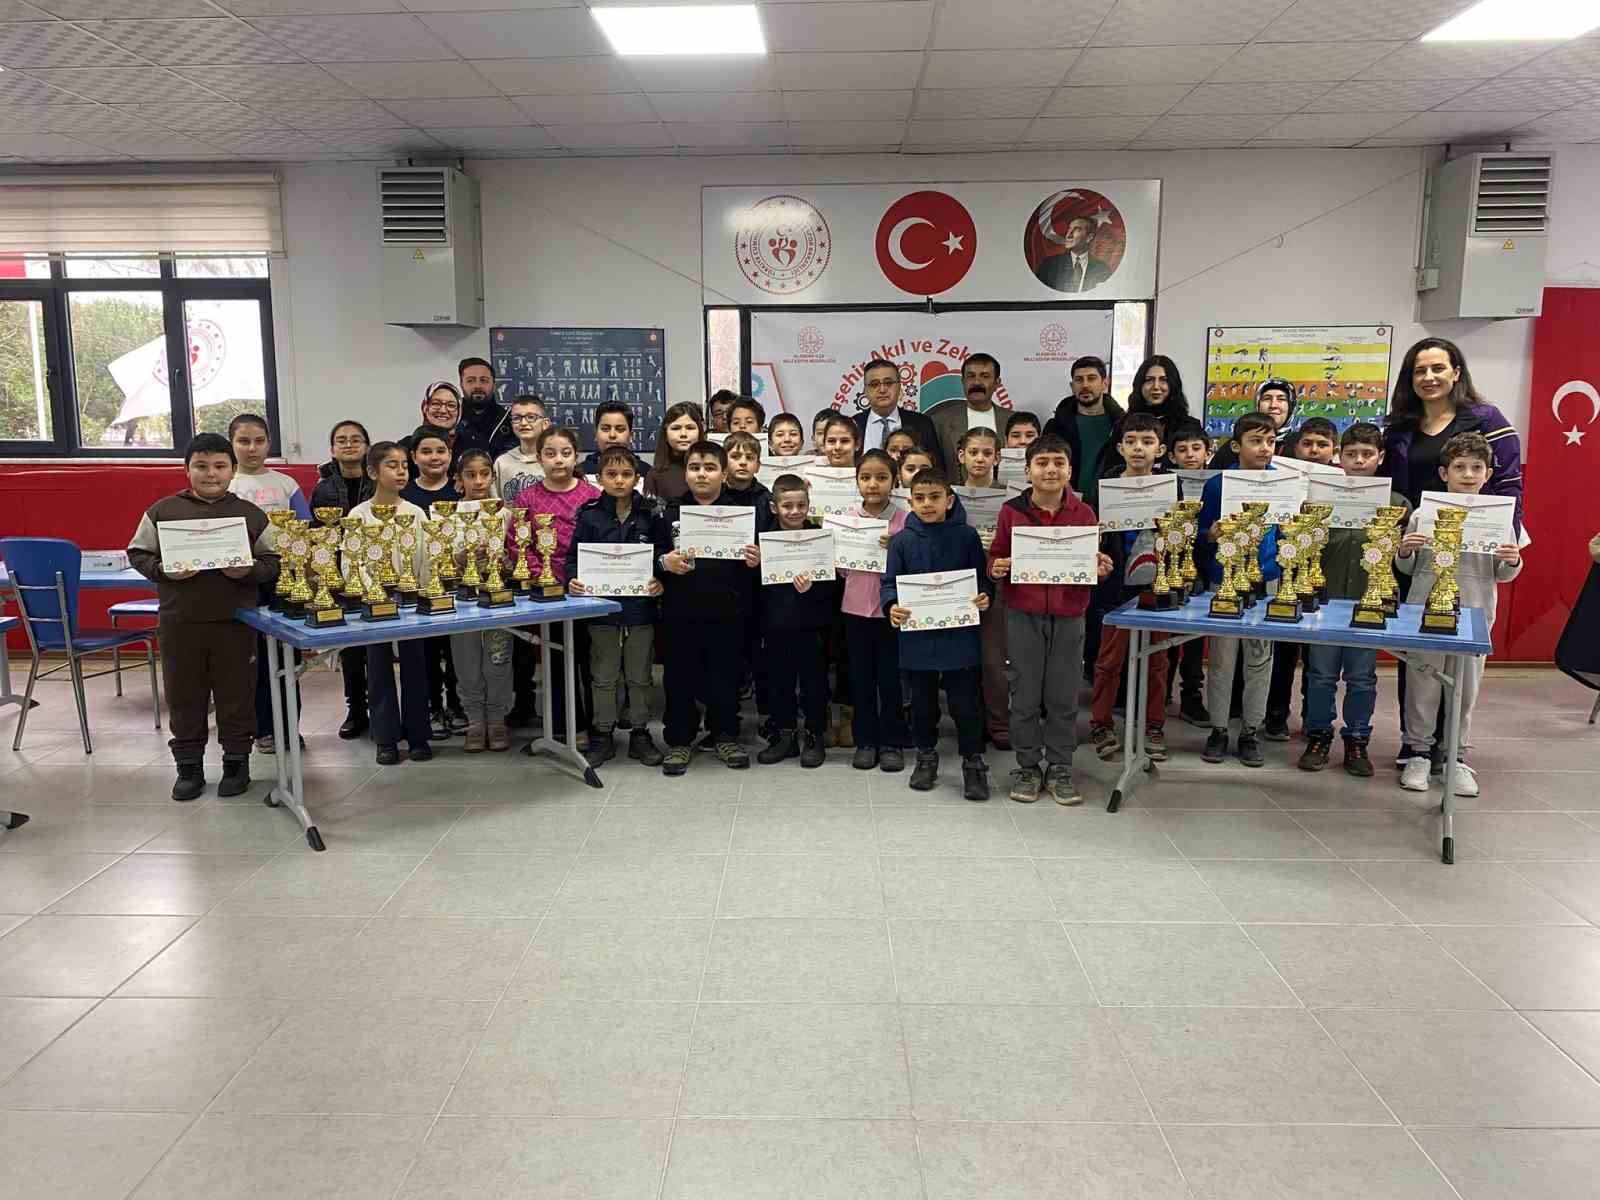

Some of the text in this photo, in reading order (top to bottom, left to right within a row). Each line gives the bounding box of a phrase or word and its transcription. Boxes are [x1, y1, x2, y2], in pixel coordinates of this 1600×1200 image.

[831, 361, 866, 411] aşehir
[870, 339, 905, 361] Akıl
[911, 340, 933, 353] ve
[936, 339, 971, 361] Zek
